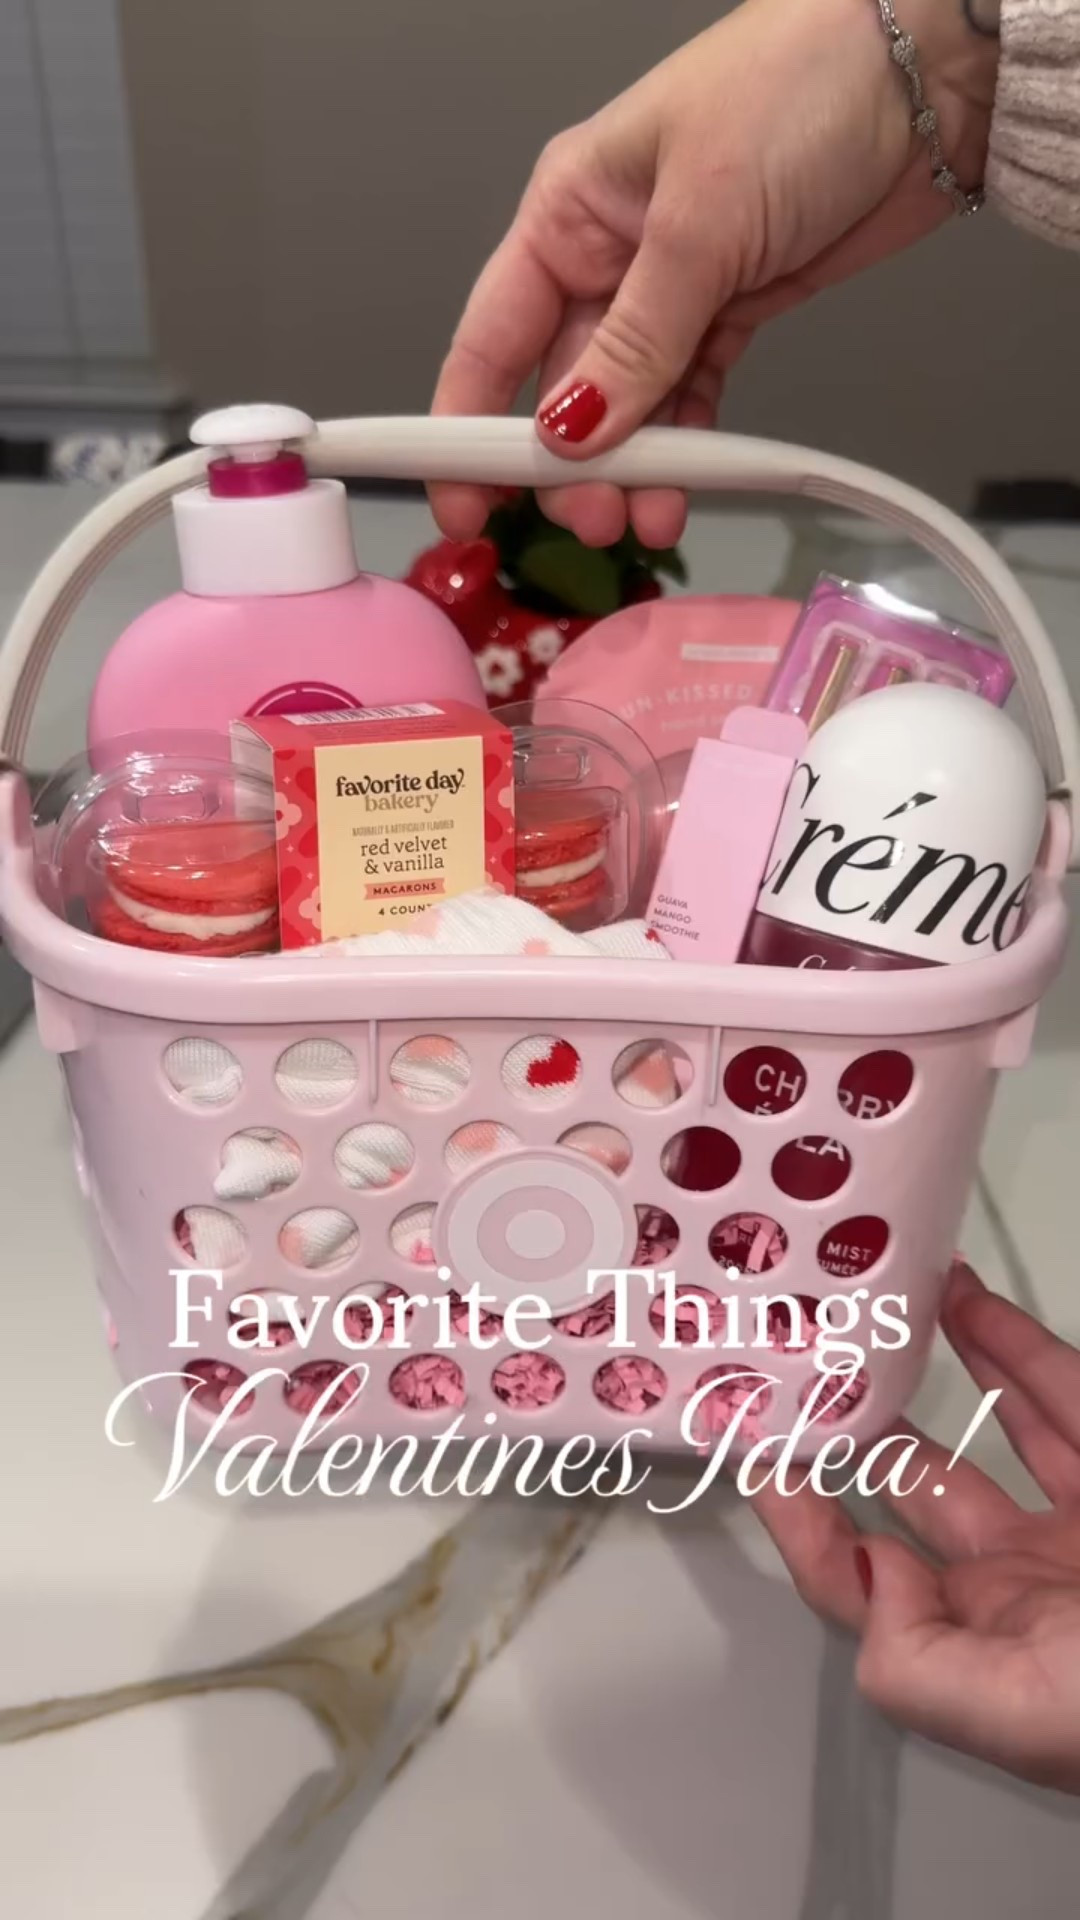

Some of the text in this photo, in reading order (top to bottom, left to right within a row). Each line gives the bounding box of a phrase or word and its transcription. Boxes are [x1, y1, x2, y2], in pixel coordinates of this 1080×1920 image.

[336, 768, 464, 797] favorite day
[364, 794, 439, 813] bakery
[361, 836, 447, 857] red velvet
[364, 853, 444, 874] & vanilla
[373, 882, 437, 895] MACARONS
[657, 894, 688, 909] GUAVA
[378, 908, 385, 916] 4
[654, 908, 692, 924] MANGO
[650, 920, 700, 941] SMOOTHIE
[826, 1242, 872, 1262] MIST
